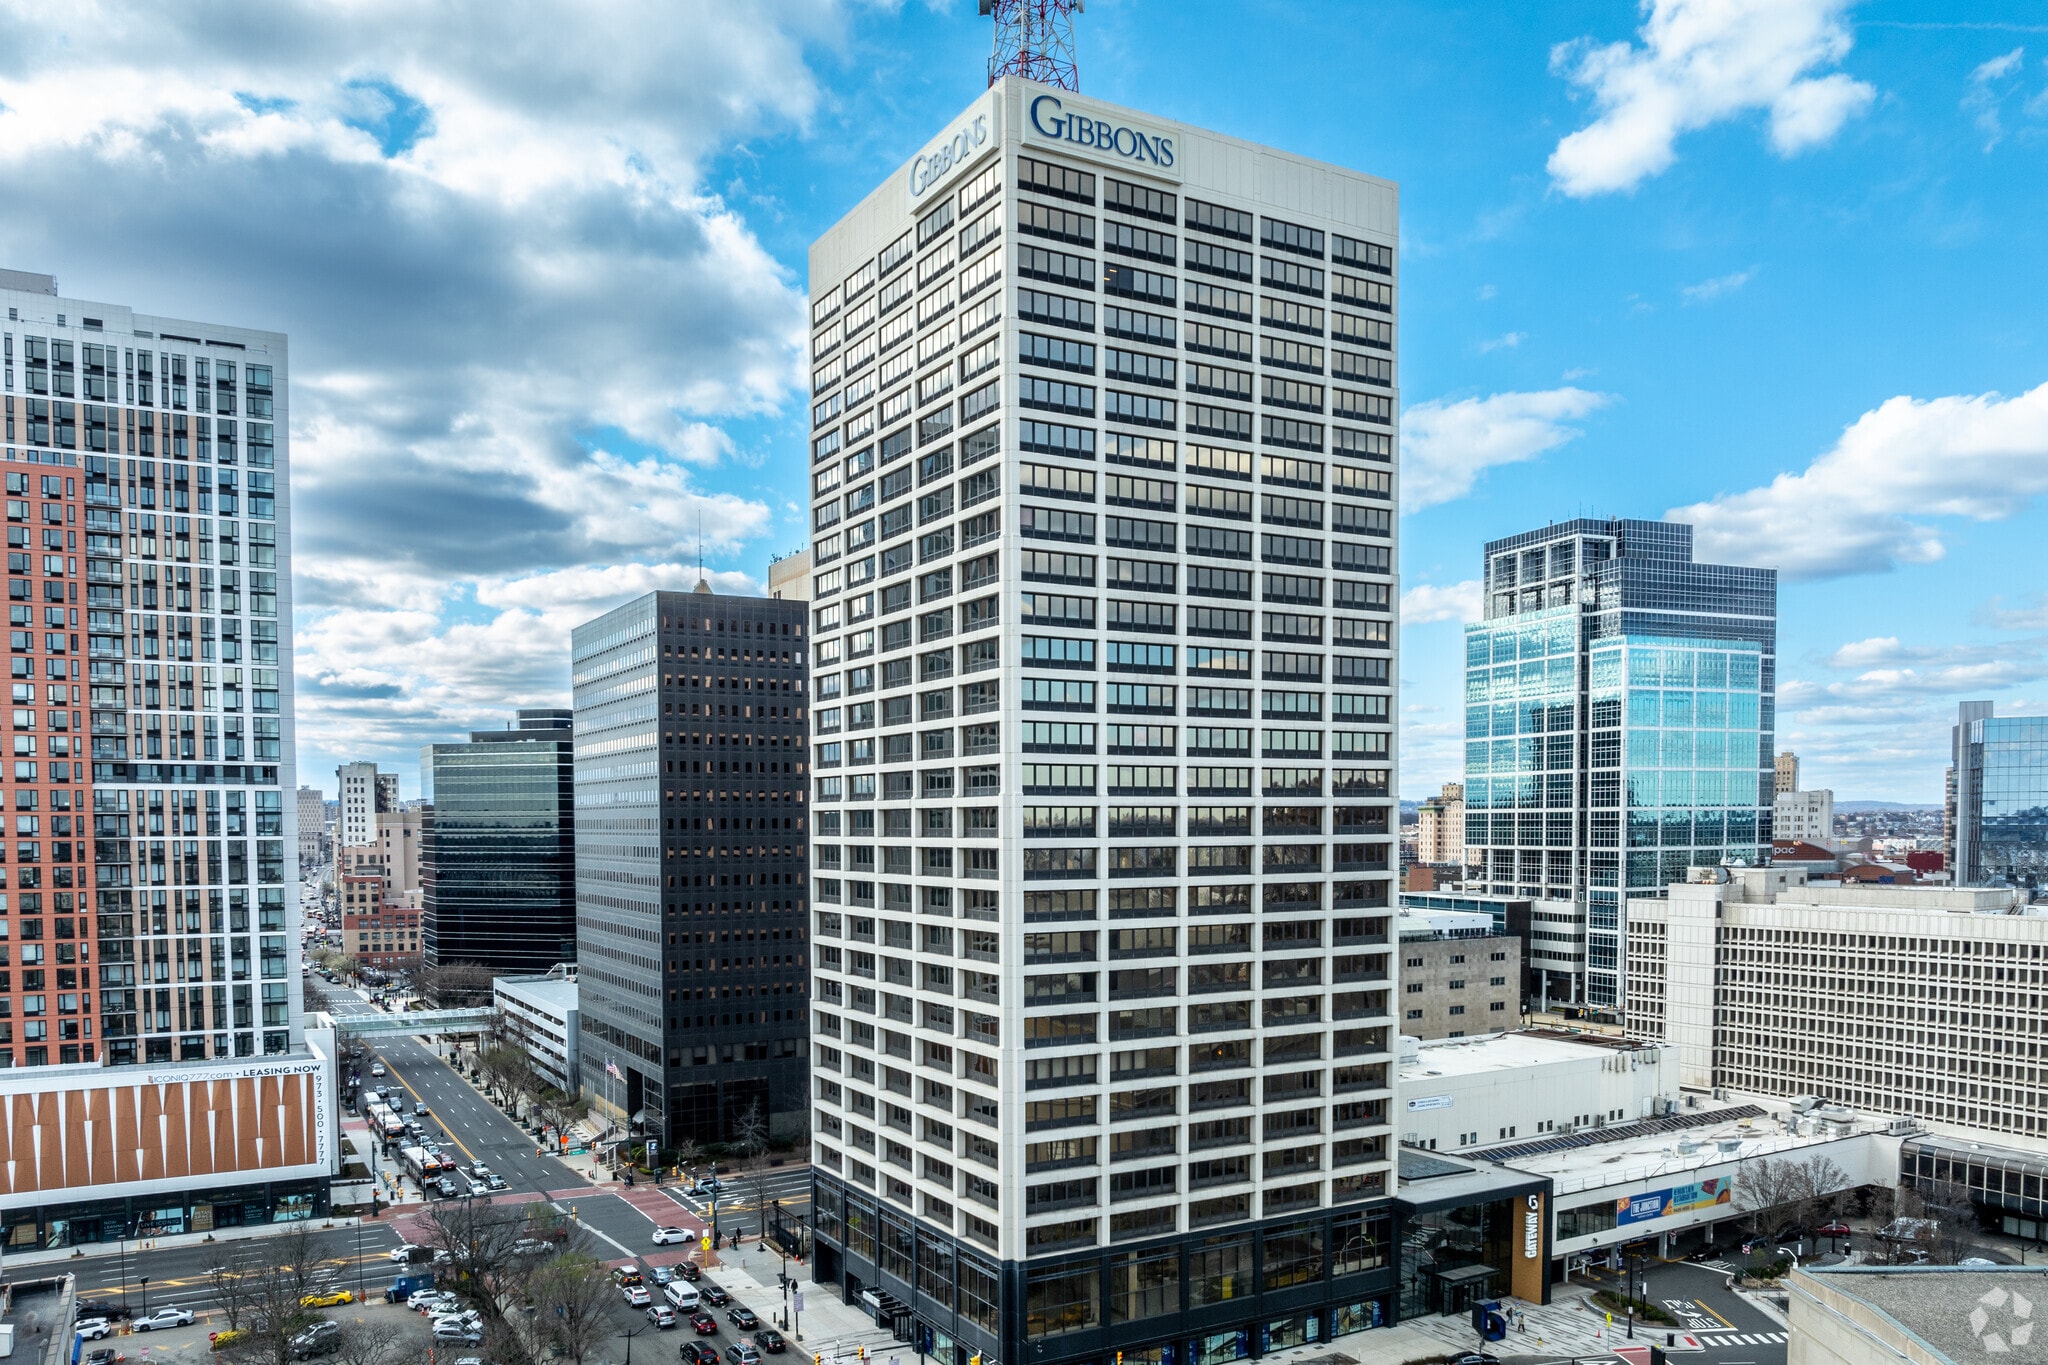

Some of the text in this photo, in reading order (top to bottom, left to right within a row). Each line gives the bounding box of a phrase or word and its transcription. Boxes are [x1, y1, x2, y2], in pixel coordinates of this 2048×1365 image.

[909, 113, 987, 197] GIBBONS
[1030, 95, 1174, 168] GIBBONS
[243, 1066, 291, 1077] LEASING
[294, 1065, 321, 1074] NOW
[1525, 1211, 1538, 1258] GATEWAY
[1687, 1317, 1722, 1329] STOP
